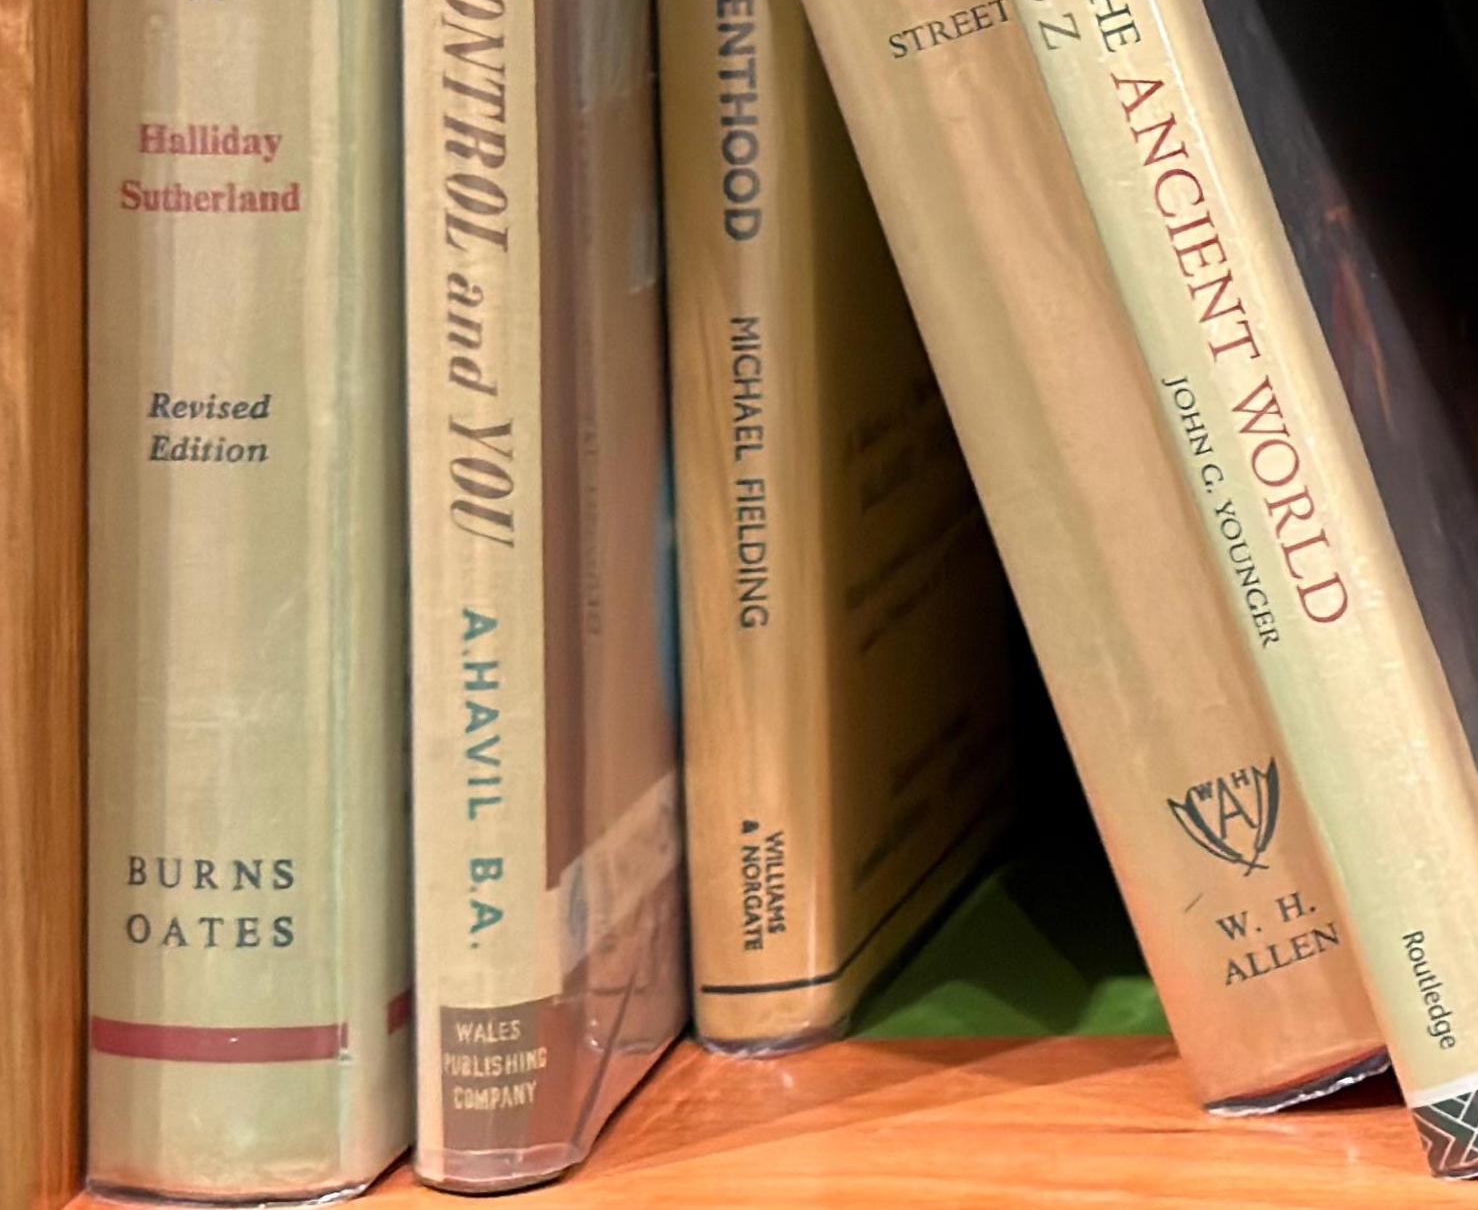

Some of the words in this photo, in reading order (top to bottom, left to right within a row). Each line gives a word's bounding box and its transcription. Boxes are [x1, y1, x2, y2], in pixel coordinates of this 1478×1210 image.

[138, 125, 282, 162] Halliday
[120, 180, 300, 213] Sutherland
[446, 273, 498, 396] and
[1111, 72, 1260, 364] ANCIENT
[1232, 375, 1349, 626] WORLD
[147, 390, 271, 422] Revised
[730, 315, 766, 463] MICHAEL
[148, 434, 268, 464] Edition
[449, 418, 515, 548] YOU
[735, 477, 770, 630] FIELDING
[1214, 499, 1280, 649] YOUNGER
[127, 856, 296, 891] BURNS
[741, 845, 763, 953] NORGATE
[765, 831, 786, 934] WILLIAMS
[126, 915, 295, 949] OATES
[1224, 922, 1340, 986] ALLEN
[1401, 930, 1456, 1051] Routledge
[443, 1047, 548, 1077] PUBLISHING
[456, 1019, 521, 1042] WALES
[454, 1081, 537, 1111] COMPANY
